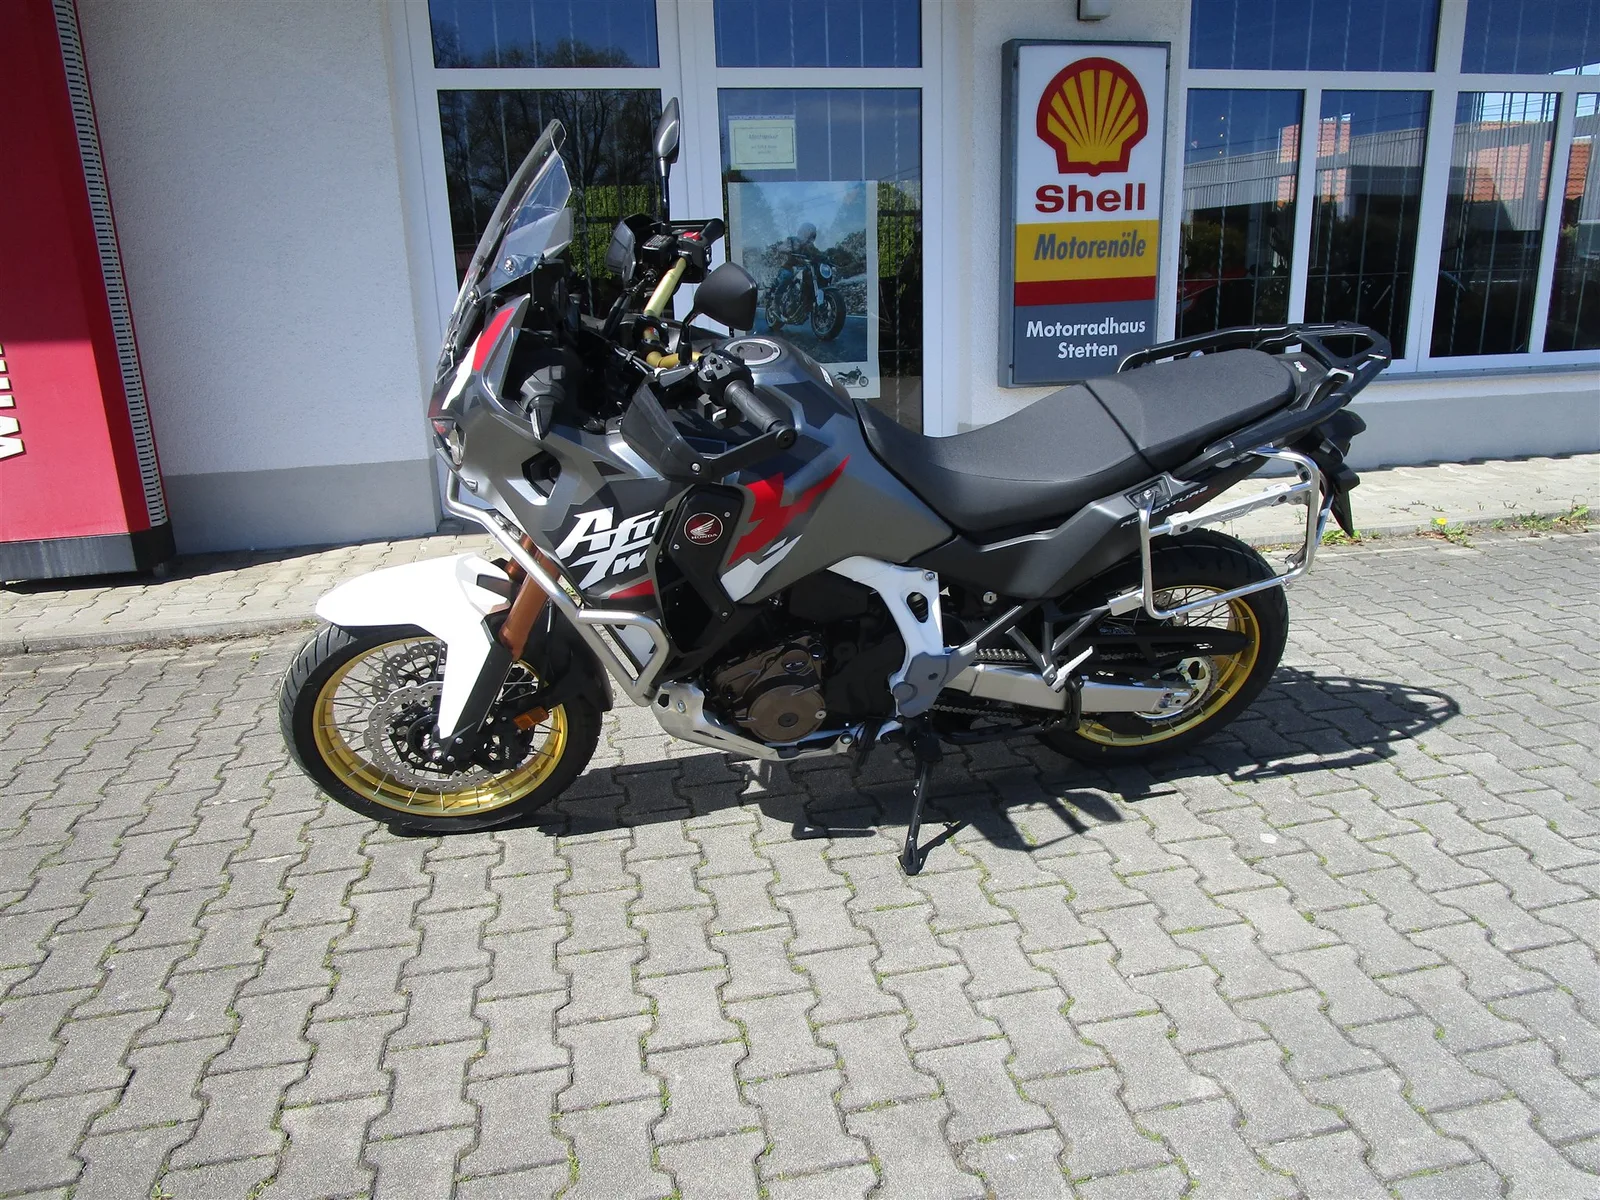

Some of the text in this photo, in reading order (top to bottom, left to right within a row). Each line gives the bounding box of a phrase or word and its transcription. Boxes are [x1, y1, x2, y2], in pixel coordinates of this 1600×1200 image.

[1035, 183, 1146, 213] Shell
[1034, 230, 1146, 260] Motorenöle
[1026, 317, 1146, 338] Motorradhaus
[1057, 341, 1118, 359] Stetten
[1120, 485, 1209, 528] ADENTURE
